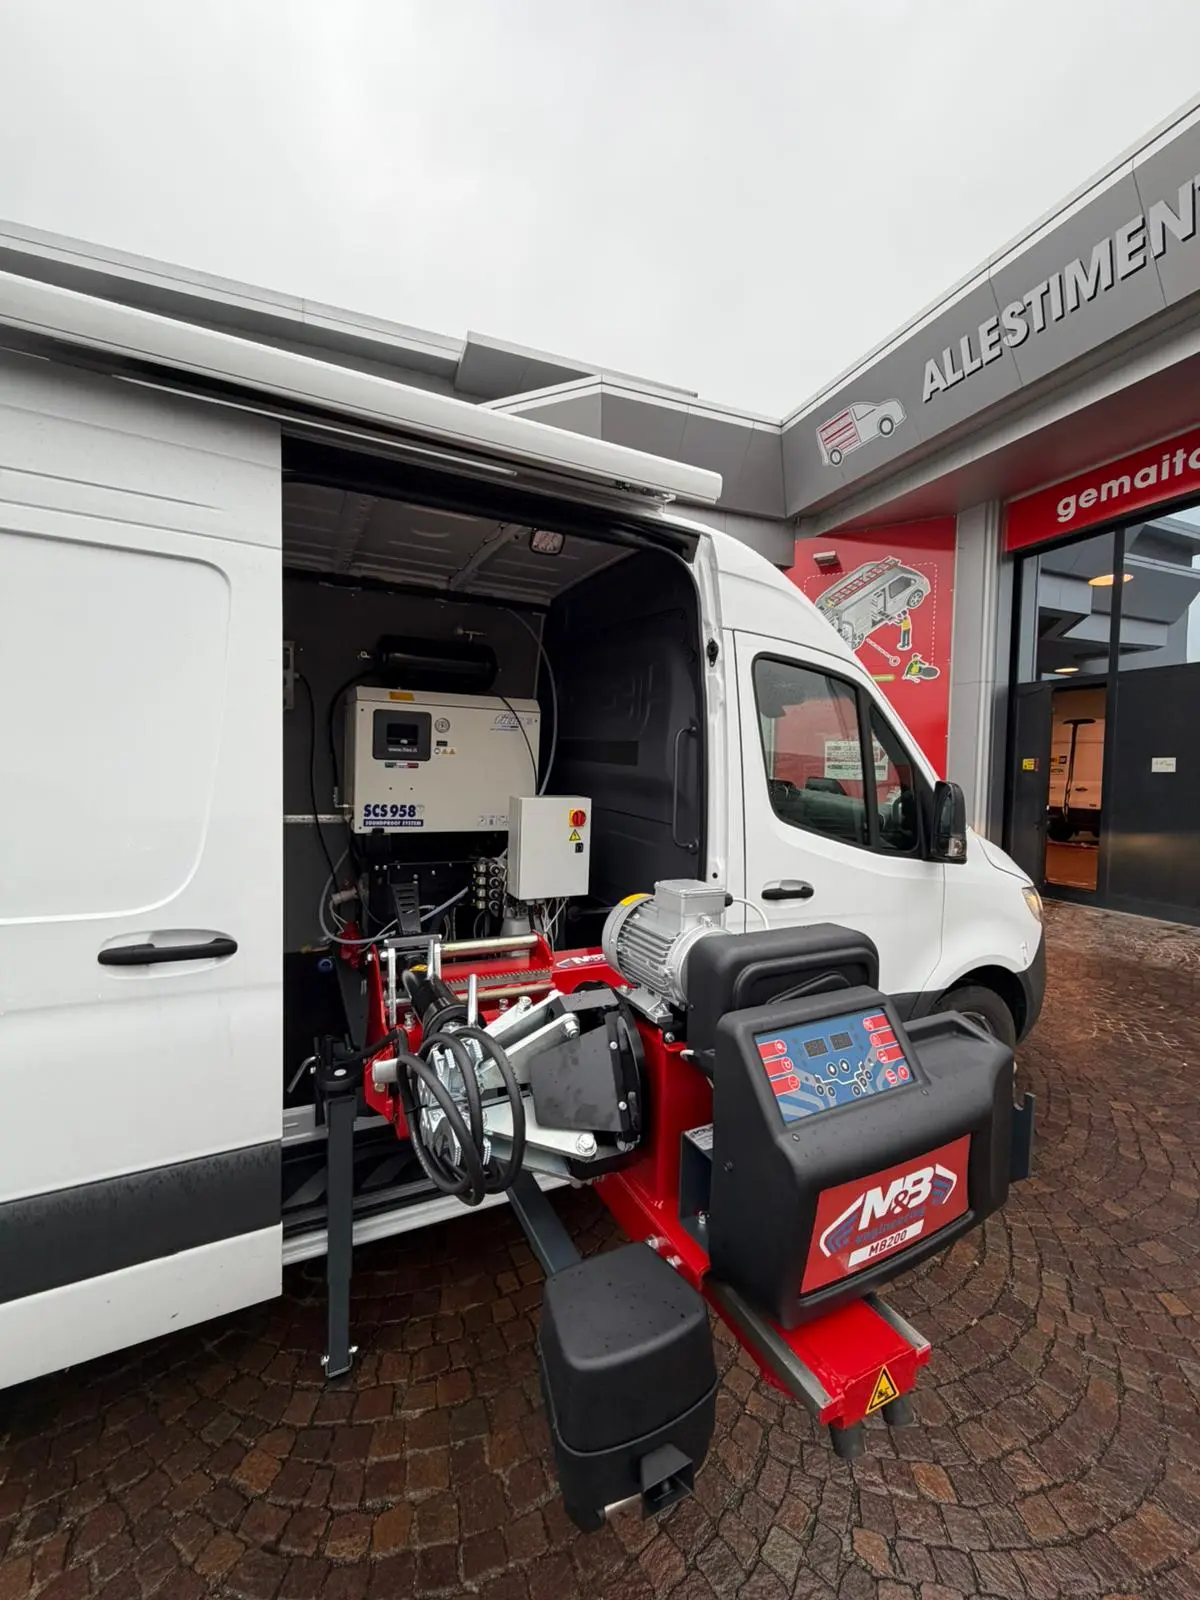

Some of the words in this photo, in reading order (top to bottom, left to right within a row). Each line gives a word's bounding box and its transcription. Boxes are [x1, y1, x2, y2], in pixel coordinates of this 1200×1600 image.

[922, 172, 1200, 402] ALLESTIMEN
[858, 1166, 935, 1231] M&B
[868, 1230, 908, 1257] MB200
